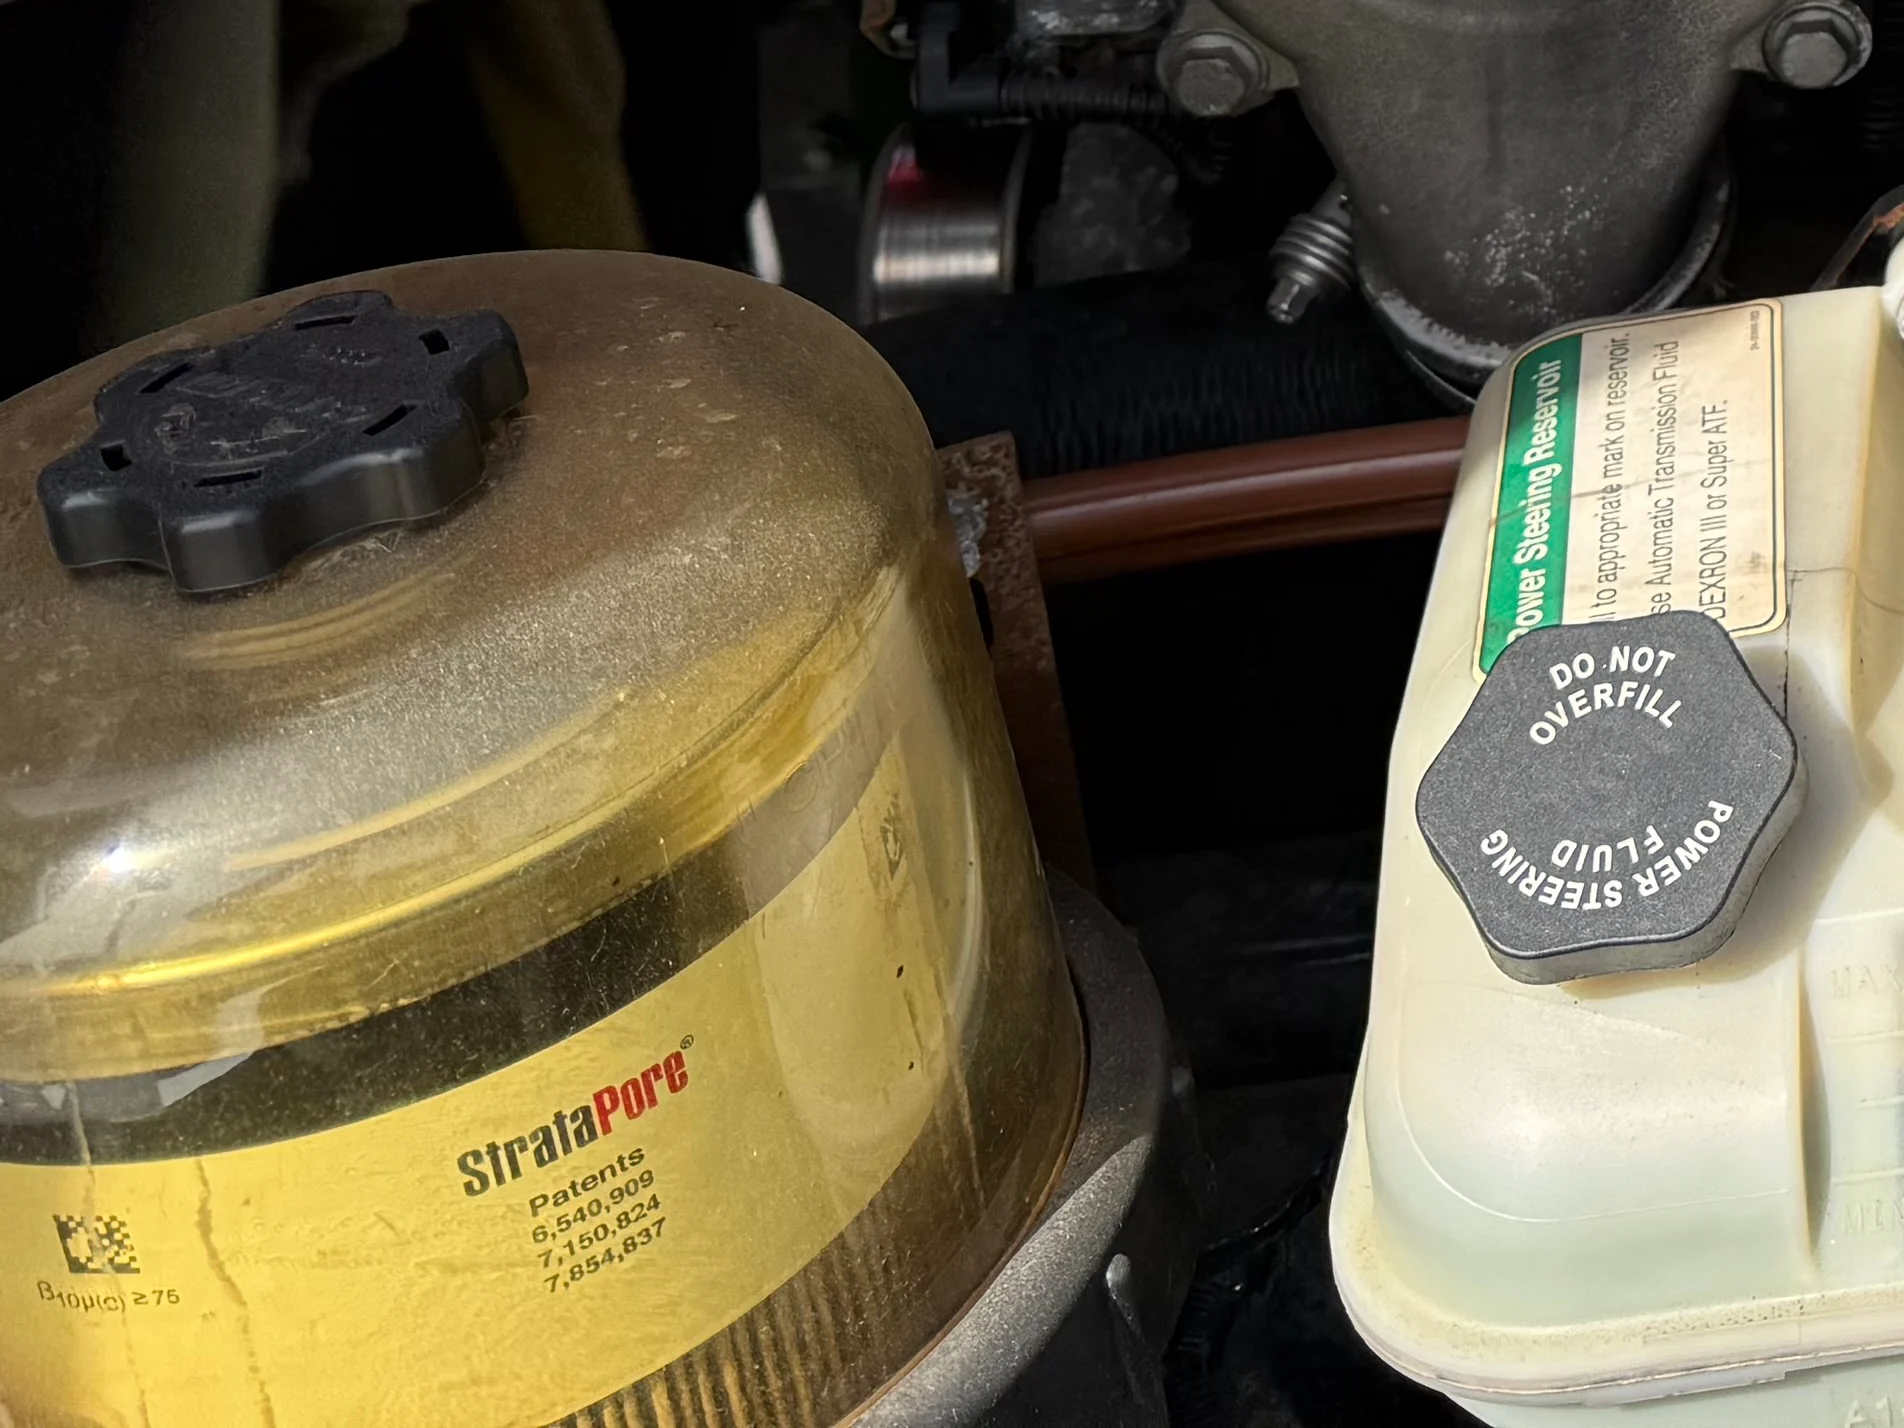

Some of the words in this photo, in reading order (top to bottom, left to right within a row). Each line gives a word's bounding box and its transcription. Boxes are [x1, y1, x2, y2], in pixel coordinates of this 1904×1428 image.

[1607, 331, 1630, 408] reservoir.
[1653, 339, 1679, 383] Fluid
[1525, 359, 1562, 467] Reservoir
[1607, 412, 1626, 432] on
[1648, 383, 1679, 496] Transmission
[1701, 398, 1729, 435] ATF.
[1599, 433, 1624, 480] mark
[1700, 442, 1735, 488] Super
[1513, 462, 1562, 566] Steering
[1594, 482, 1626, 585] appropriate
[1708, 494, 1728, 511] or
[1648, 495, 1674, 587] Automatic
[1597, 587, 1617, 611] to
[1651, 591, 1672, 616] se
[1698, 536, 1728, 623] DEXRON
[1549, 652, 1596, 690] DO
[1608, 645, 1676, 678] NOT
[1529, 680, 1682, 745] OVERFILL
[1480, 828, 1624, 911] STEERING
[1551, 824, 1665, 873] FLUID
[1632, 799, 1735, 897] POWER
[528, 1147, 646, 1218] Patents
[531, 1168, 655, 1244] 6,540,909
[536, 1192, 661, 1269] 7,150,824
[543, 1216, 667, 1294] 7,854,837
